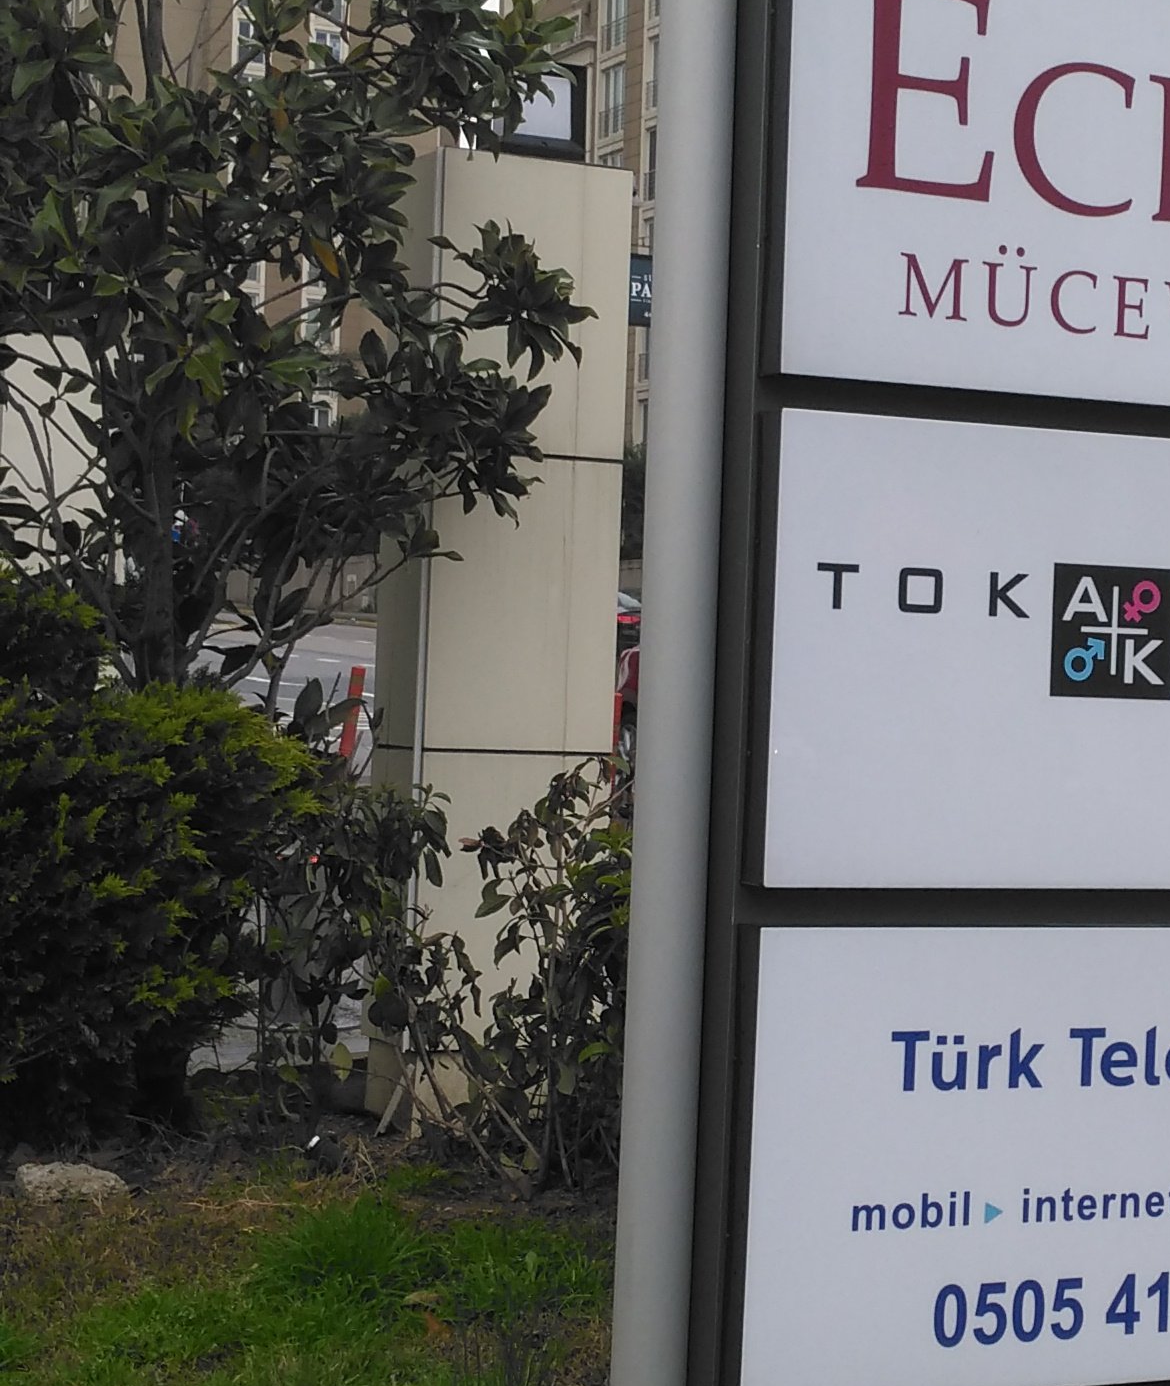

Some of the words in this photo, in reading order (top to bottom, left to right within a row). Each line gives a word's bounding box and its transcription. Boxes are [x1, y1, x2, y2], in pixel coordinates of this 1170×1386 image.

[891, 1028, 1043, 1091] Türk
[851, 1191, 972, 1231] mobil
[933, 1277, 1085, 1348] 0505
